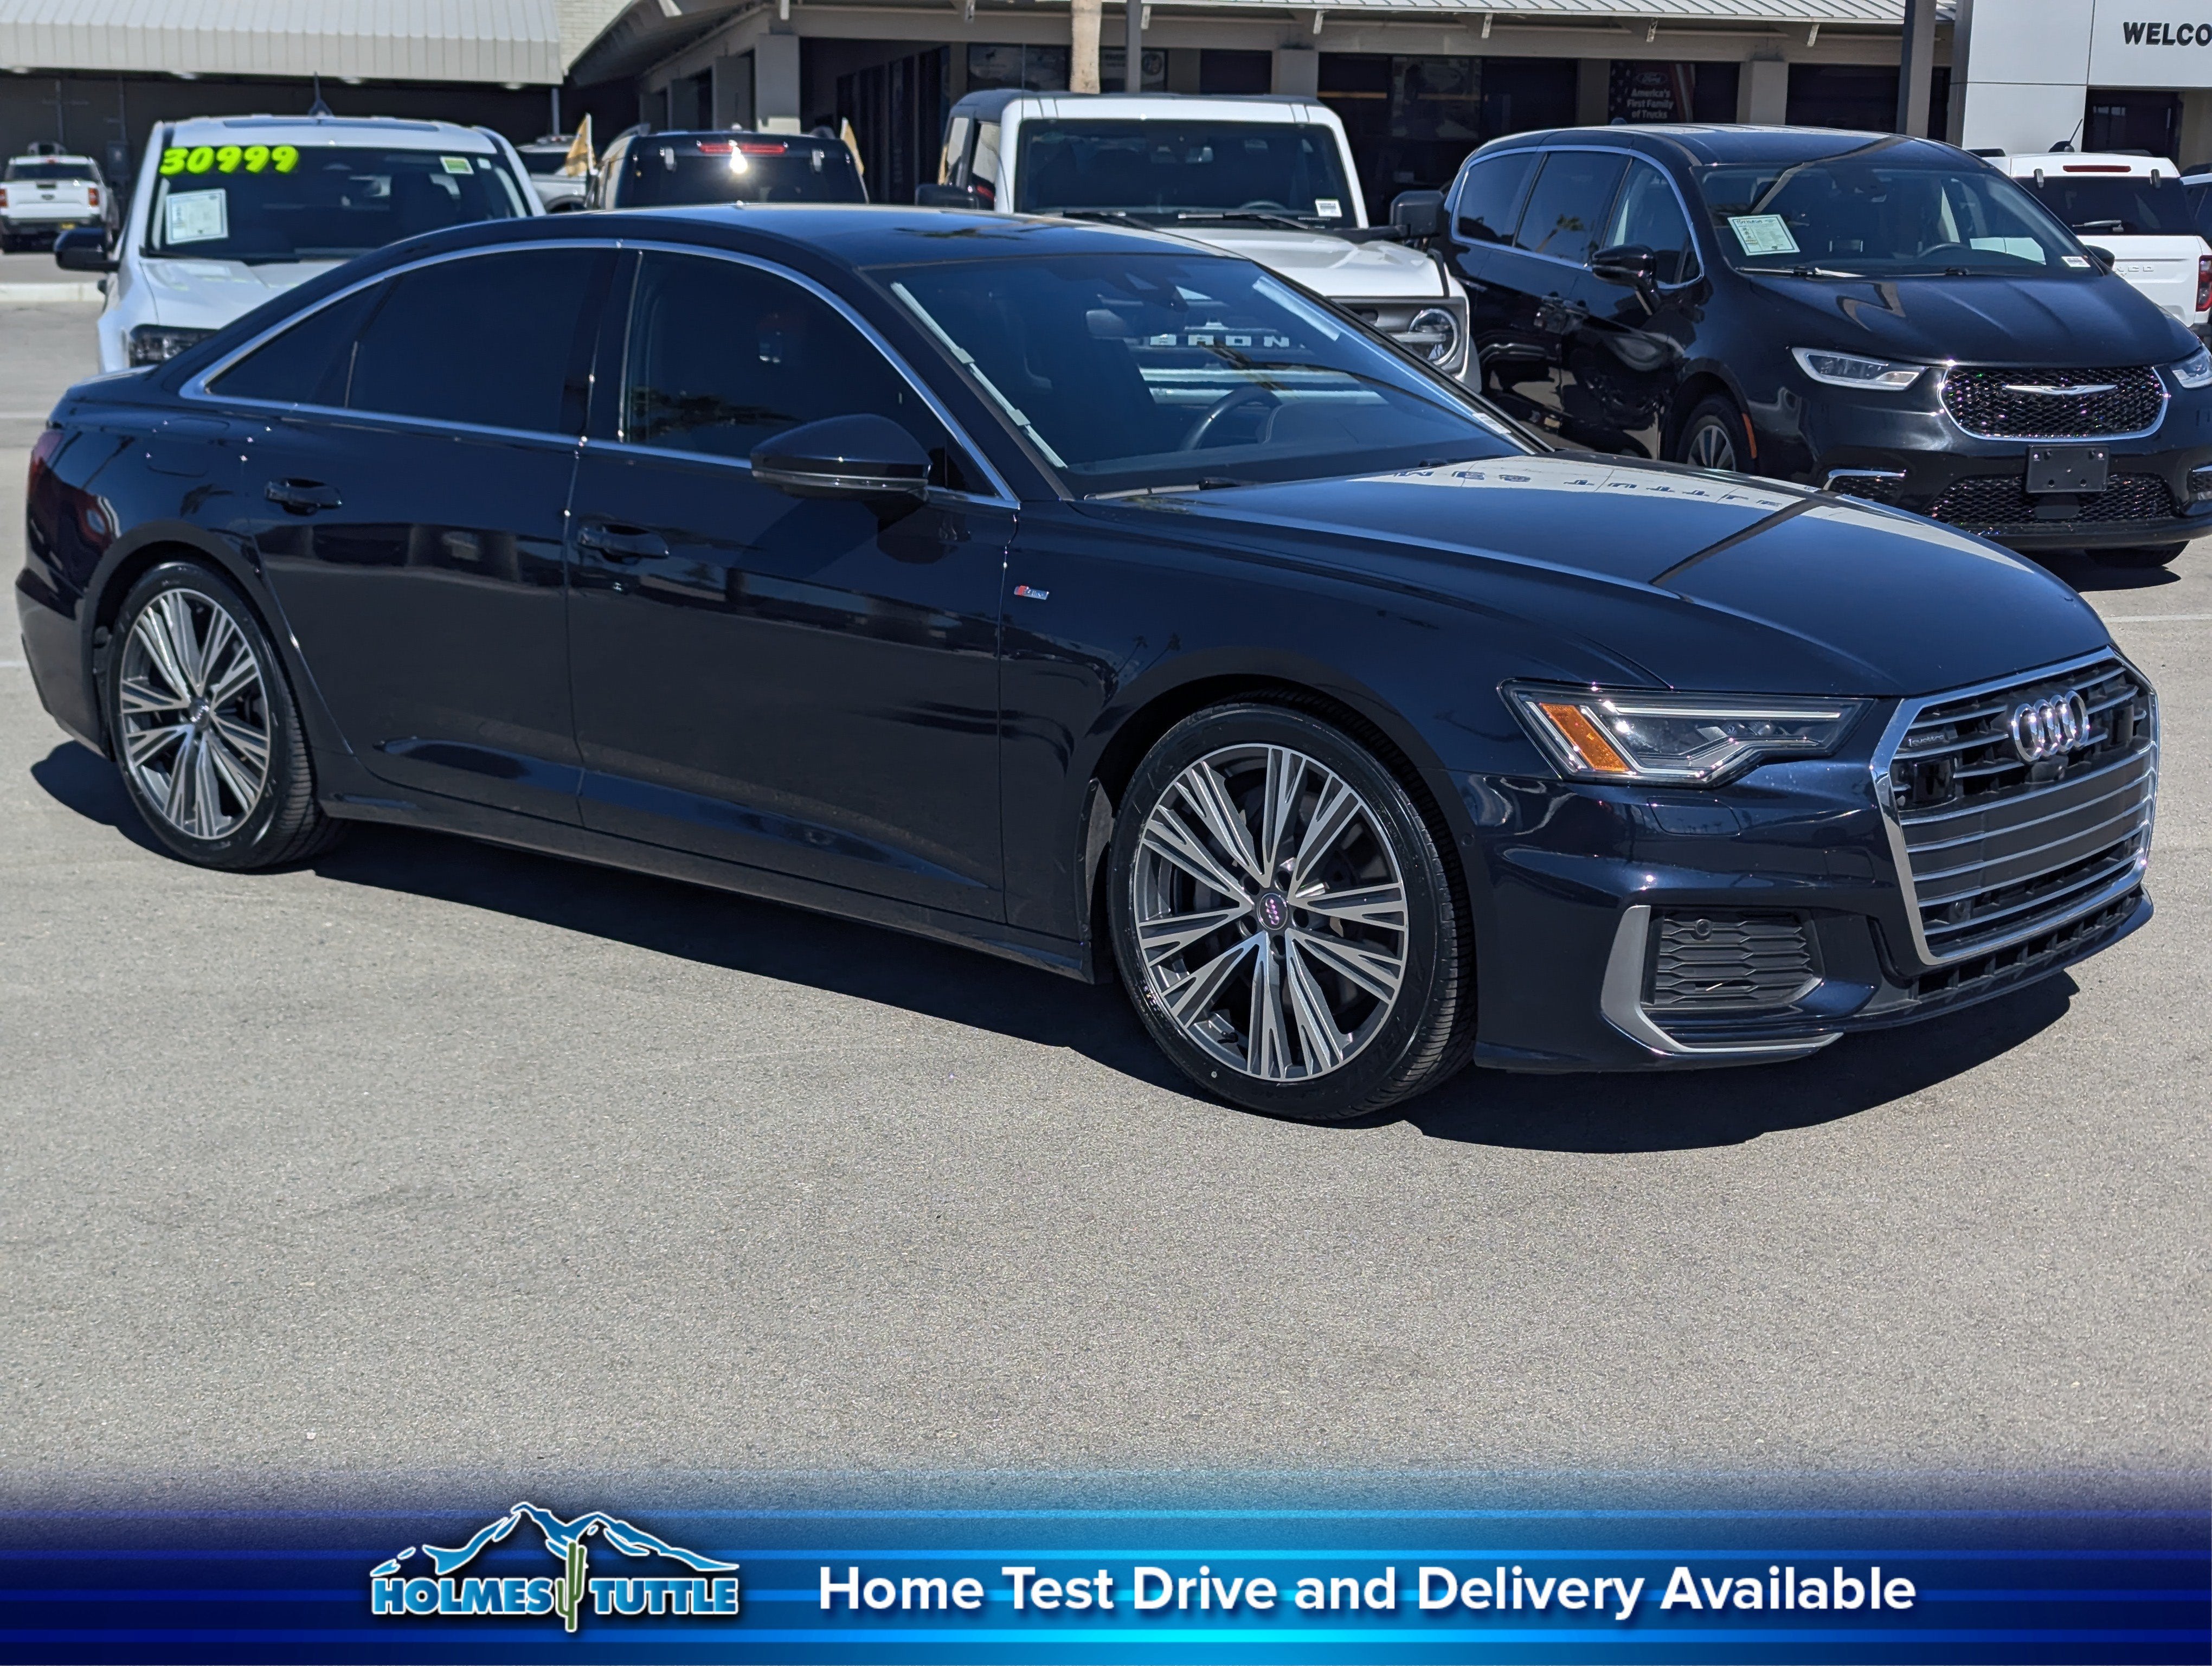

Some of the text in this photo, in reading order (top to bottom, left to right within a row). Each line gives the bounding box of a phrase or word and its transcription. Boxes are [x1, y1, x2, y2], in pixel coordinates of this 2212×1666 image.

[2124, 22, 2212, 47] WELCO
[1631, 88, 1670, 98] America's
[1627, 99, 1674, 110] First Family
[1631, 110, 1668, 119] of Trucks
[159, 145, 299, 174] 30999
